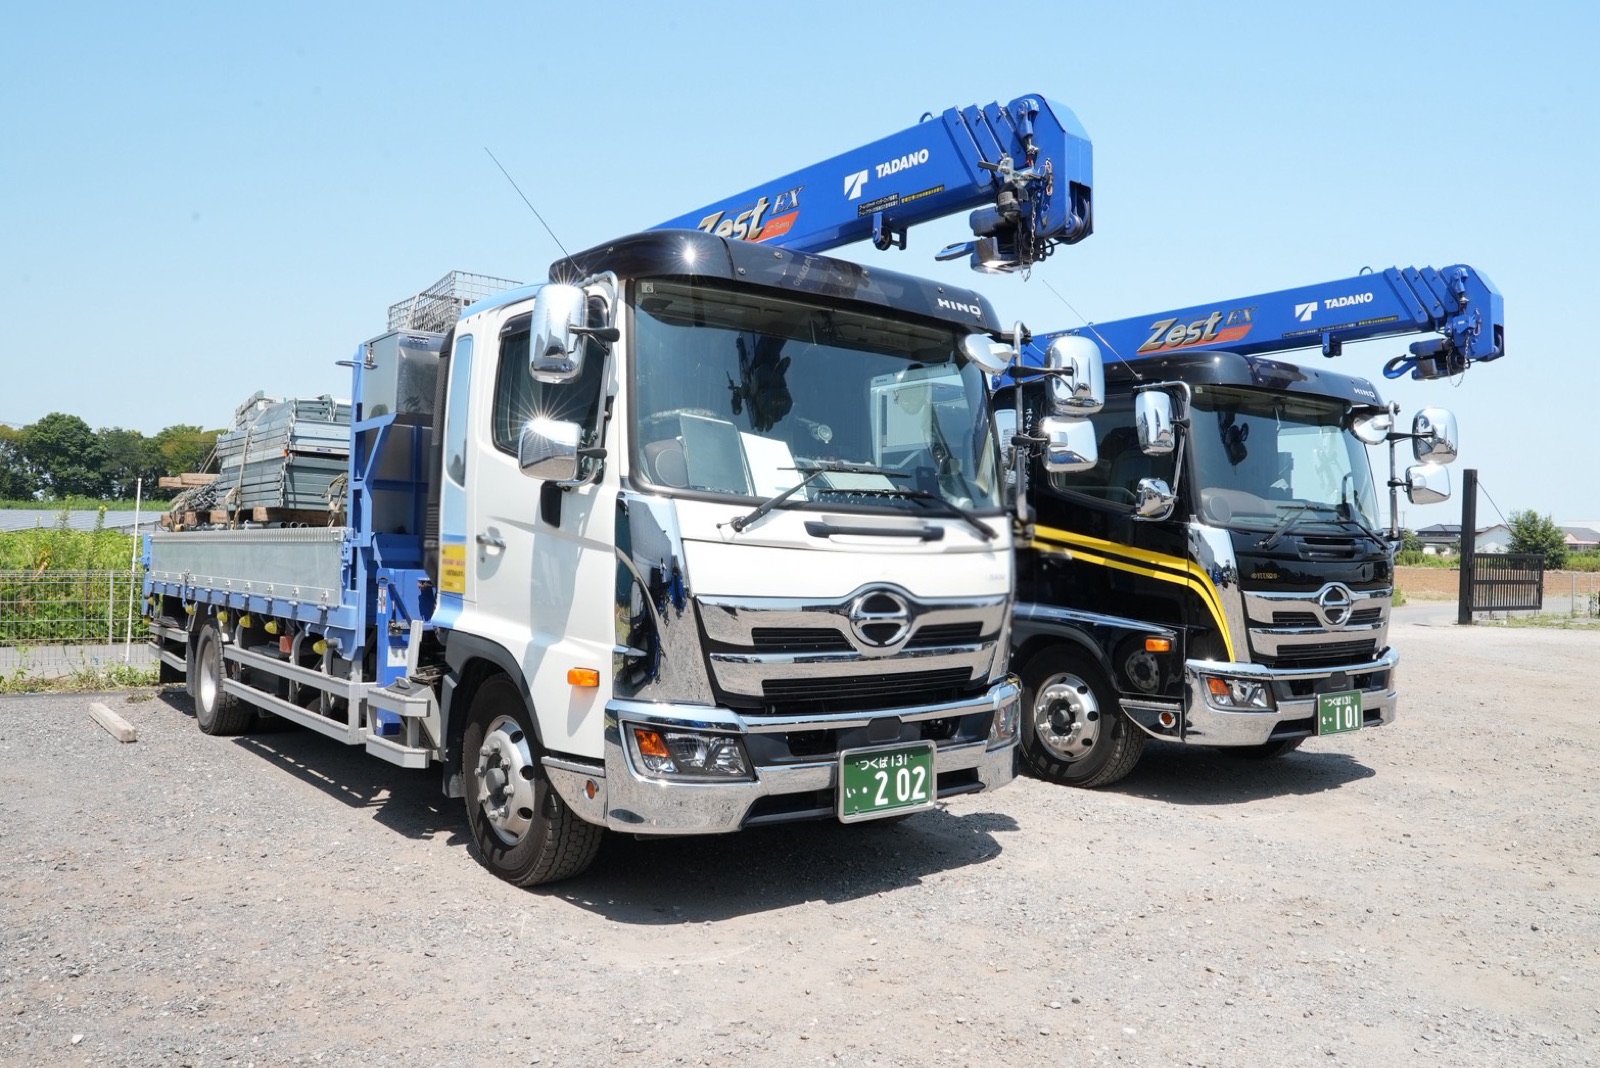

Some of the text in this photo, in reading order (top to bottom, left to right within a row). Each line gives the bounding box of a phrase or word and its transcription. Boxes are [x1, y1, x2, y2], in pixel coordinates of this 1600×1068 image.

[875, 148, 929, 179] TADANO
[770, 186, 804, 216] EX
[937, 298, 981, 316] HINO
[1324, 292, 1373, 309] TADANO
[1137, 311, 1224, 352] Zest
[1353, 387, 1375, 398] HINO
